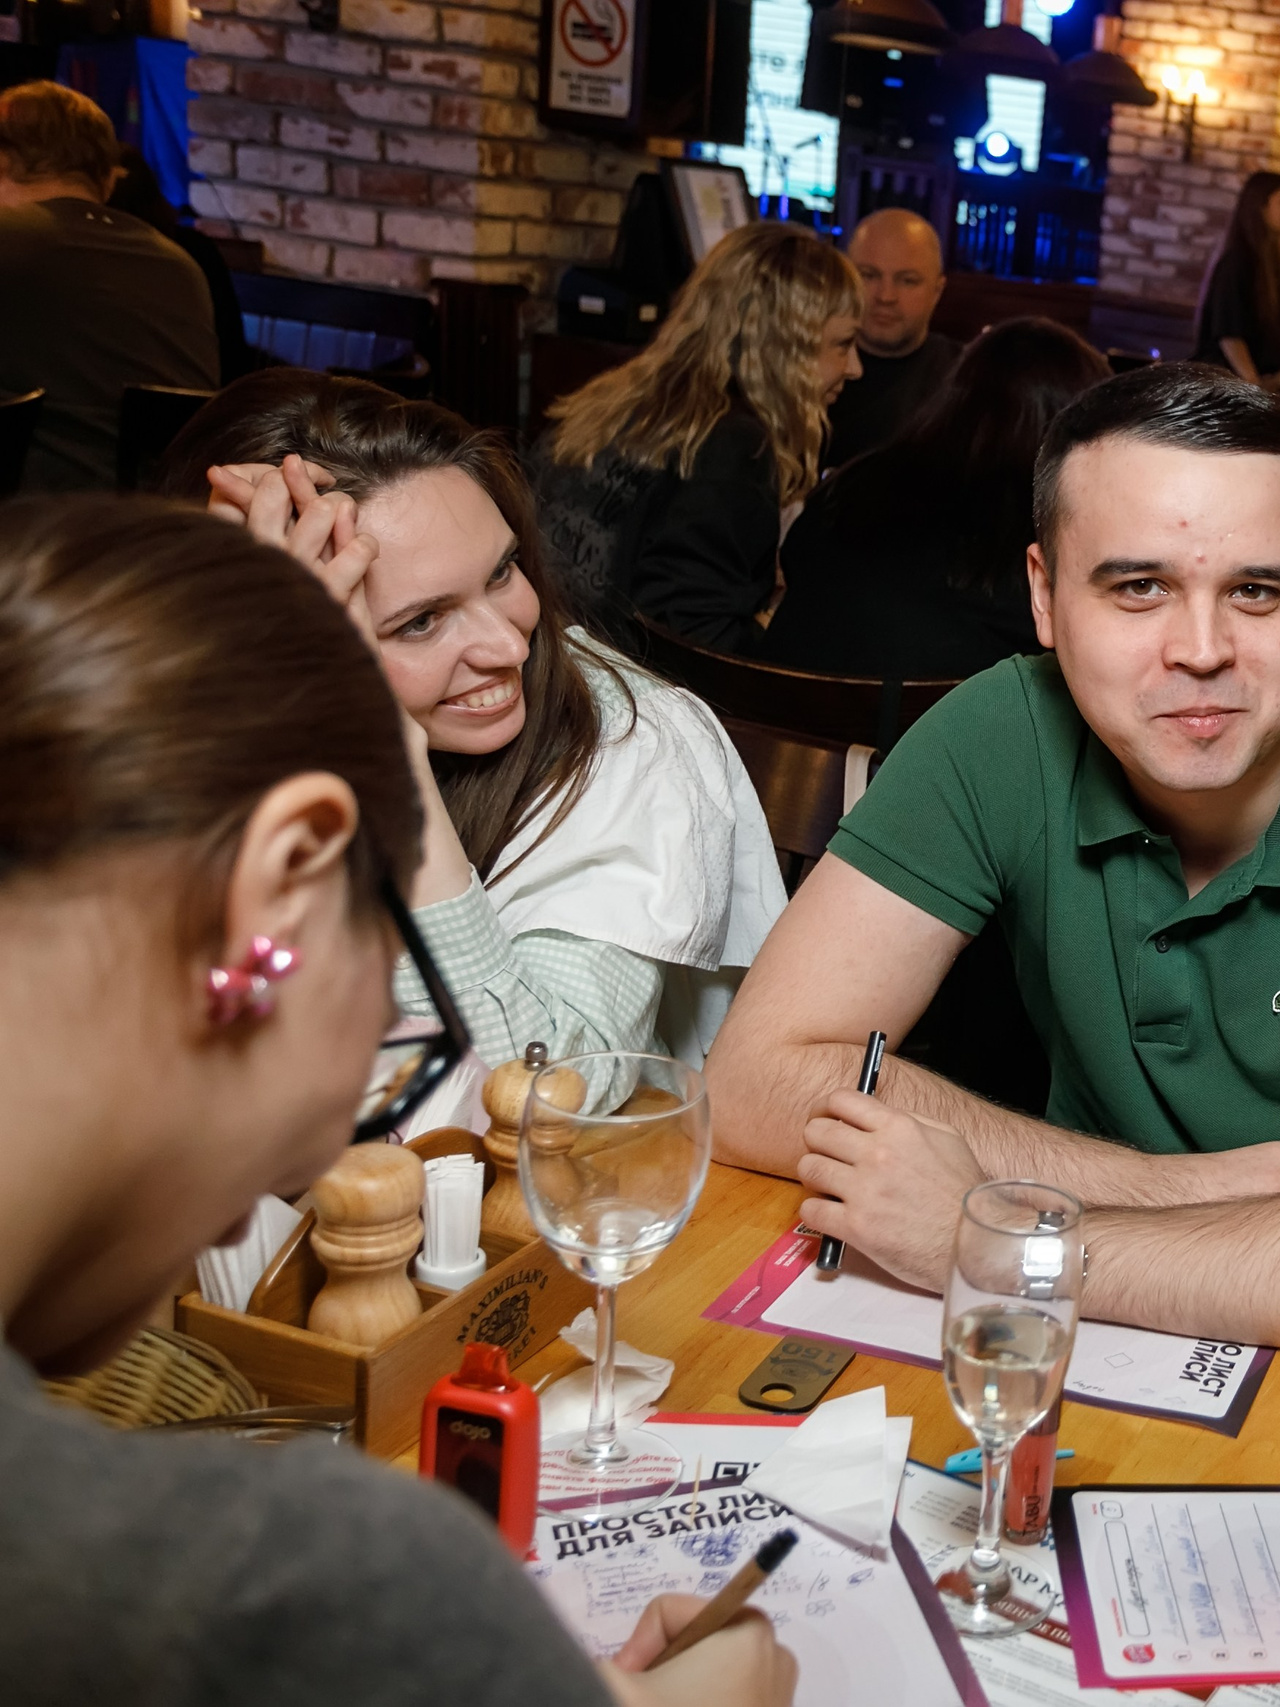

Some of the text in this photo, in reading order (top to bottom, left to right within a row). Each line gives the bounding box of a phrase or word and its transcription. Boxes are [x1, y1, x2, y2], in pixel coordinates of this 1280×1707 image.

[456, 1269, 549, 1343] MAXIMILIAN'S
[781, 1341, 837, 1363] 150
[1179, 1341, 1219, 1383] ПИСИ
[1198, 1357, 1236, 1398] ЛИСТ
[449, 1419, 492, 1441] dojo
[552, 1491, 768, 1540] ПРОСТО ЛИ
[557, 1530, 635, 1560] ДЛЯ
[647, 1504, 794, 1539] ЗАПИСИ
[1022, 1494, 1041, 1537] TABU
